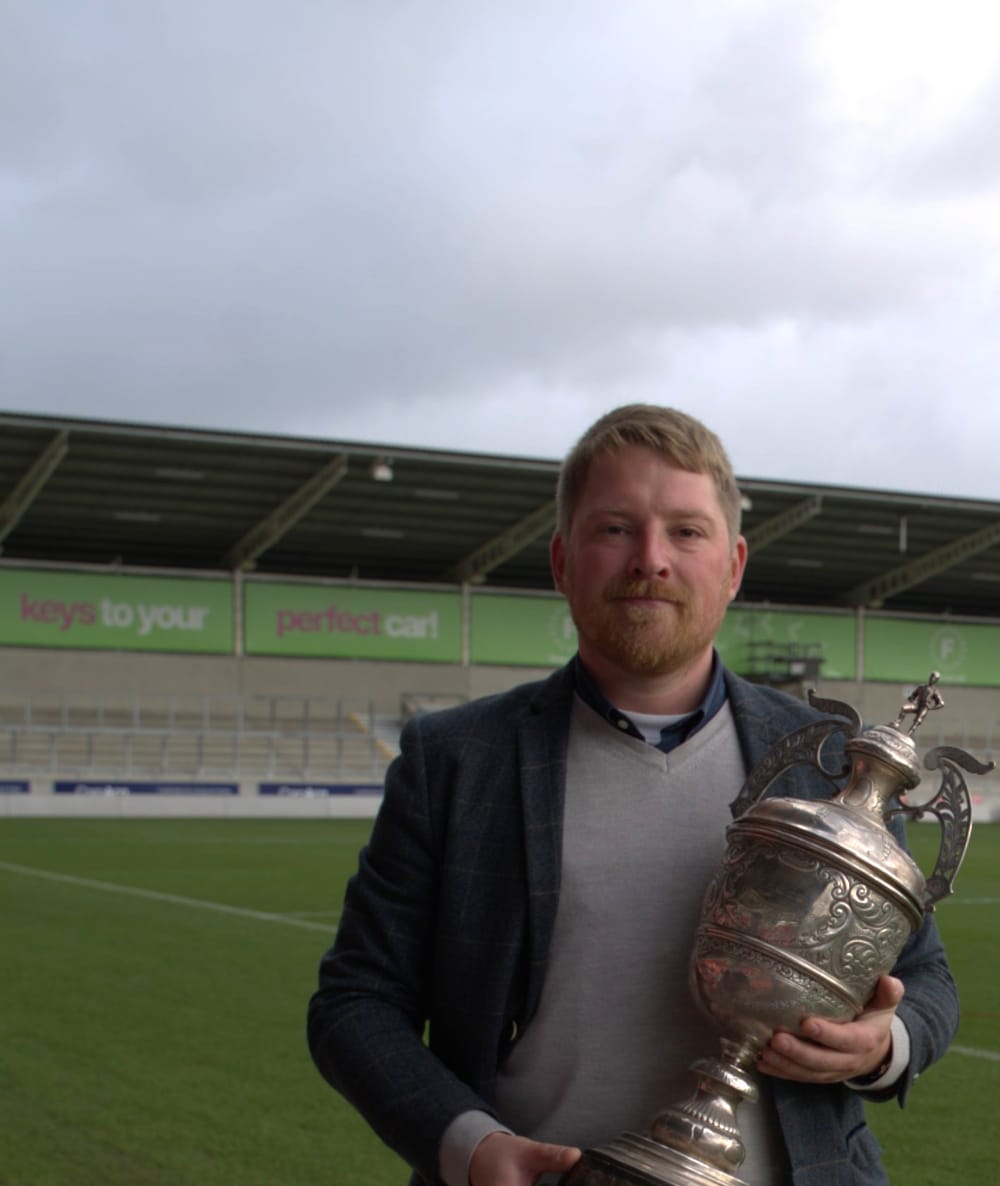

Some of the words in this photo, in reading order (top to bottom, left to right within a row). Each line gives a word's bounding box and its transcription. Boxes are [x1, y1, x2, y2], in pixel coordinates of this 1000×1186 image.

[20, 592, 97, 632] keys
[101, 597, 133, 628] to
[137, 602, 209, 636] your
[276, 604, 381, 638] perfect
[385, 611, 439, 640] car!
